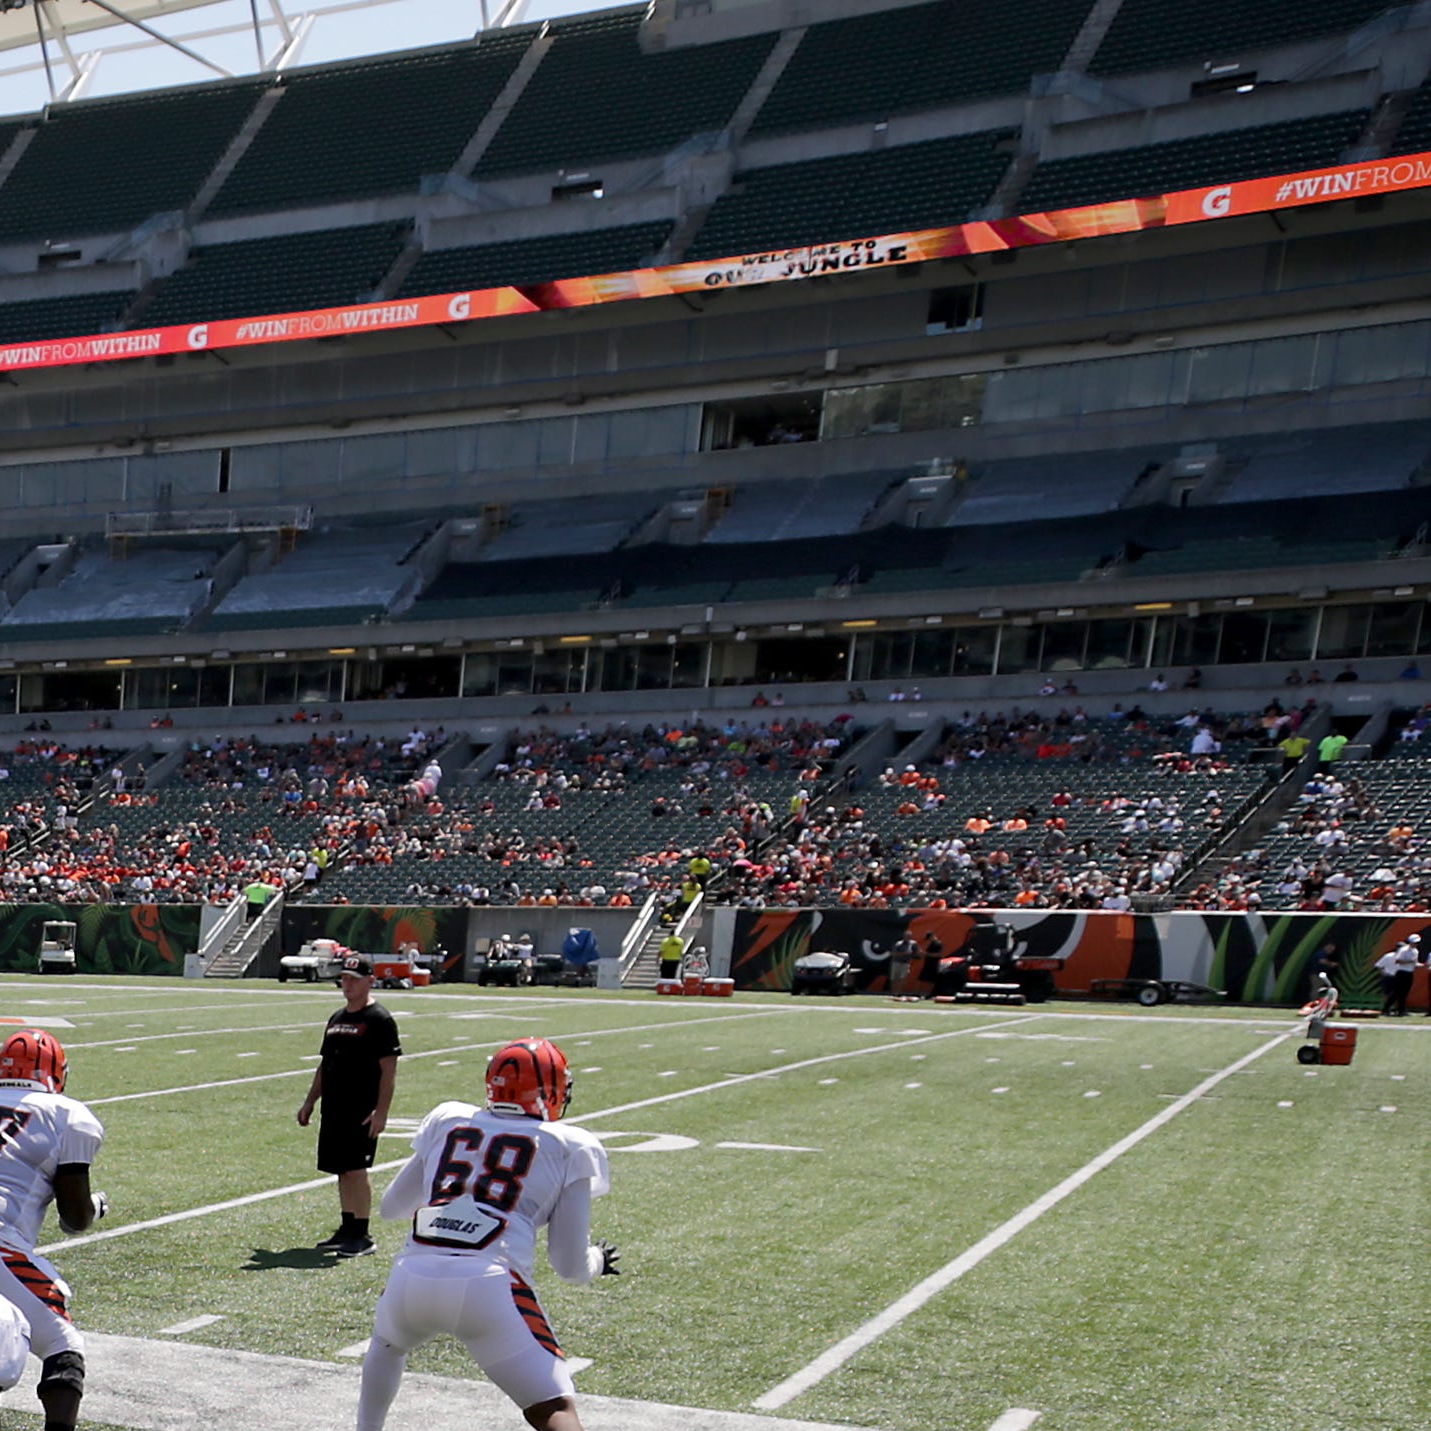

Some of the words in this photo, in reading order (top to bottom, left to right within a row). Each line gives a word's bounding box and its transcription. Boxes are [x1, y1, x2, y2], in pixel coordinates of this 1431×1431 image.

[741, 244, 841, 266] WELCME
[851, 239, 877, 251] TO
[781, 245, 908, 277] JUNGLE
[428, 1126, 537, 1213] 68
[429, 1217, 481, 1235] DOUGLAS
